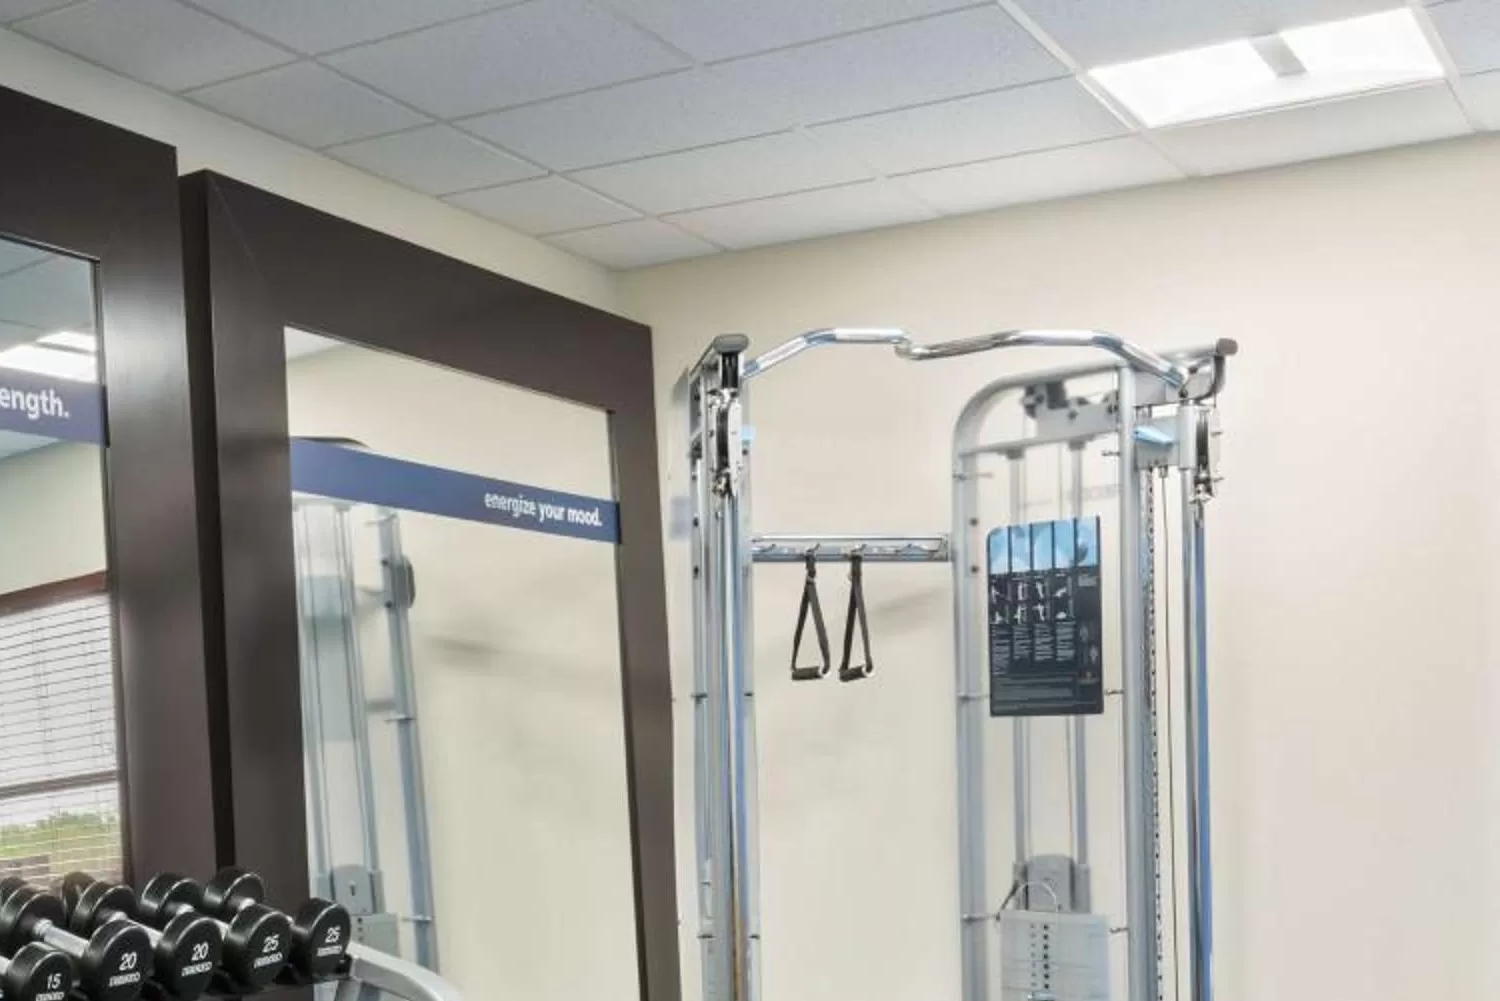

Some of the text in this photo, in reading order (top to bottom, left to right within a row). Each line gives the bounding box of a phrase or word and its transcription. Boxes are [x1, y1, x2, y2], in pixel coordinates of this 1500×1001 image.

[484, 492, 603, 527] energize your mood.
[262, 933, 280, 953] 25
[325, 925, 341, 943] 25
[119, 951, 138, 971] 20
[191, 941, 209, 961] 20
[46, 972, 62, 990] 15
